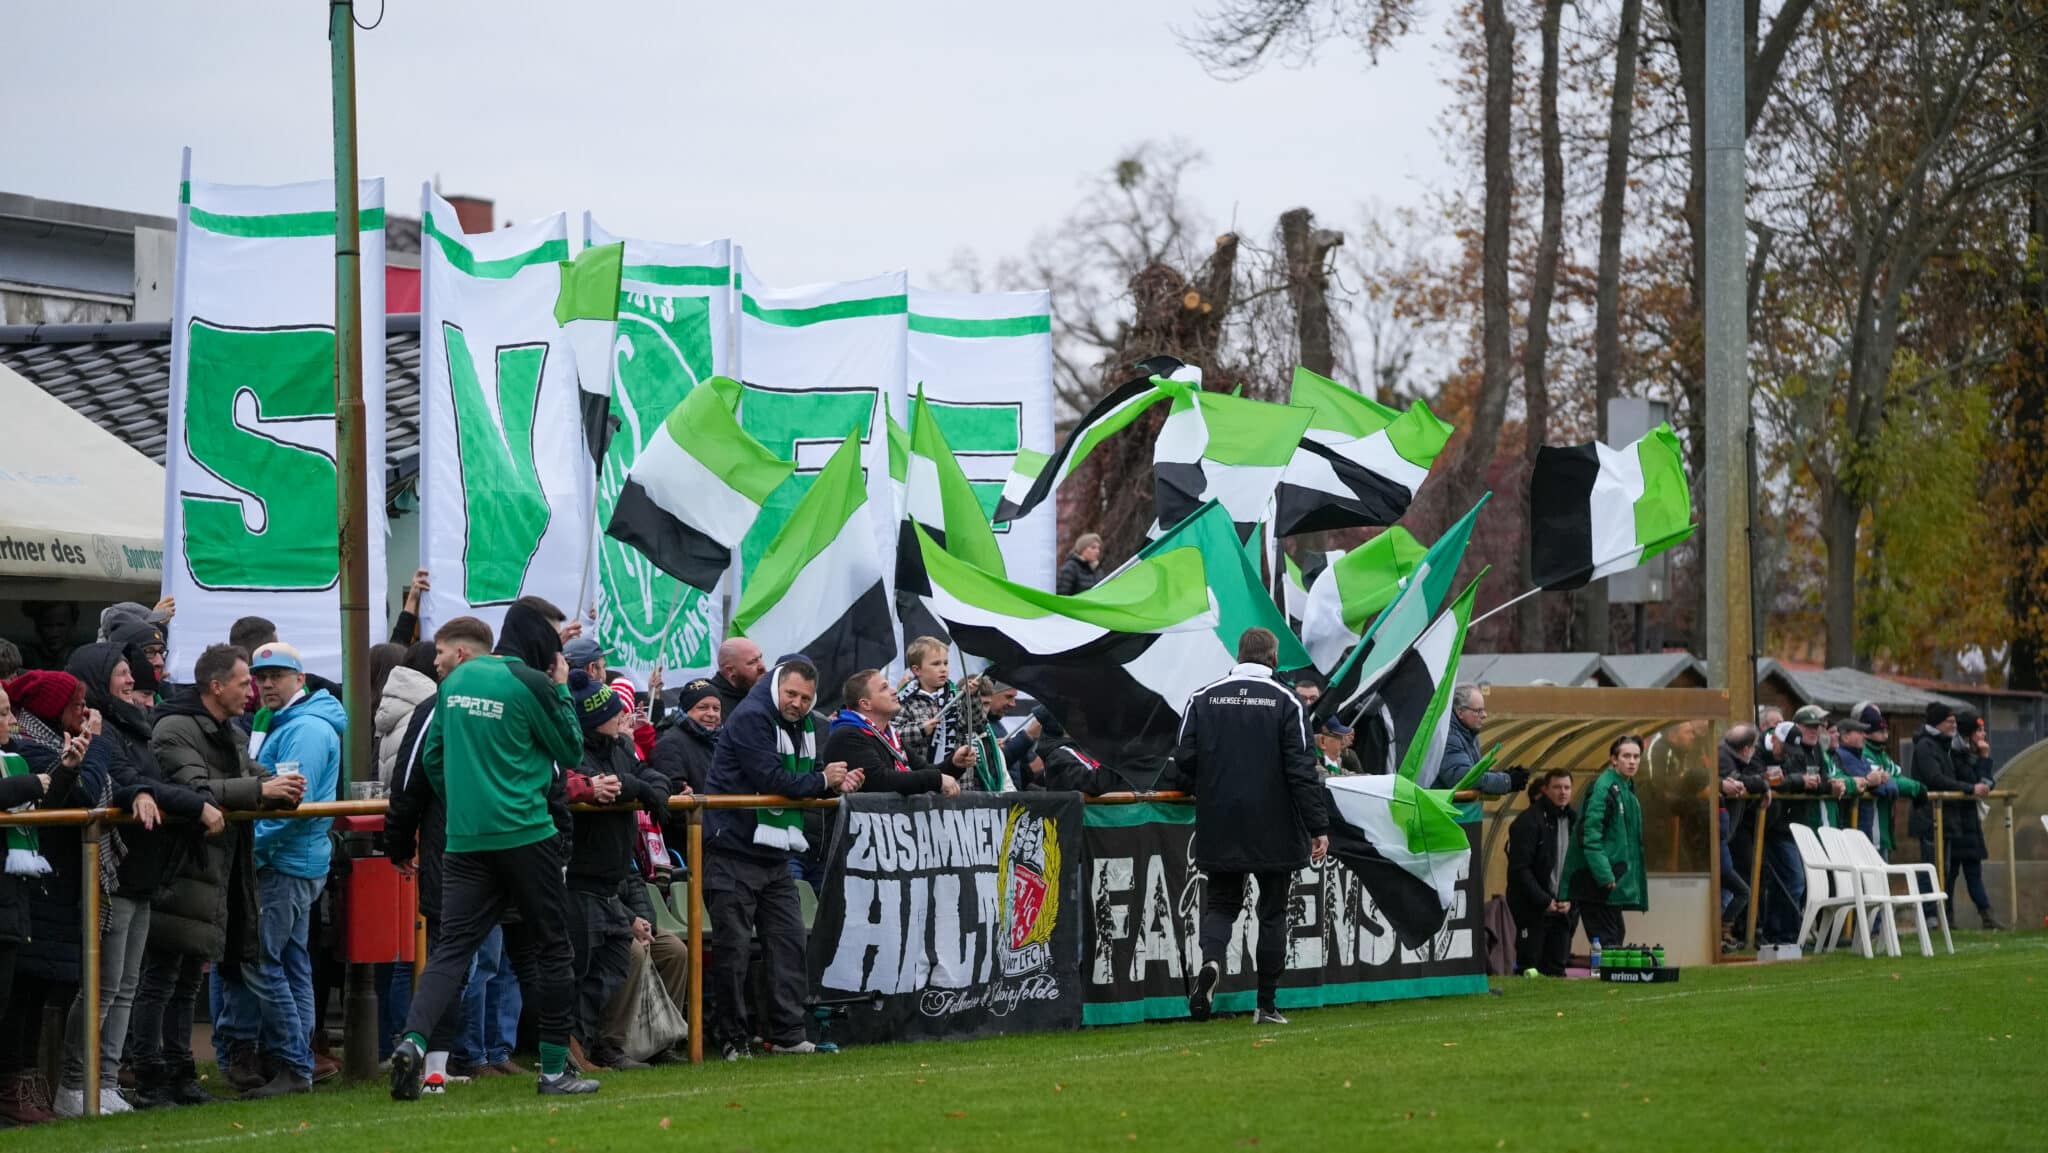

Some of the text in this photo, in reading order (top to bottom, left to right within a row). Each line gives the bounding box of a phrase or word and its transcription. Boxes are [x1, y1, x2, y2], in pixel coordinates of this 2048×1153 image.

[180, 316, 340, 593] S
[441, 319, 551, 608] V
[0, 535, 46, 562] rtner
[51, 537, 86, 565] des
[446, 695, 504, 714] SPORTS
[1239, 688, 1248, 696] SV
[846, 807, 1008, 873] ZUSAMMEN
[1610, 971, 1639, 982] erima
